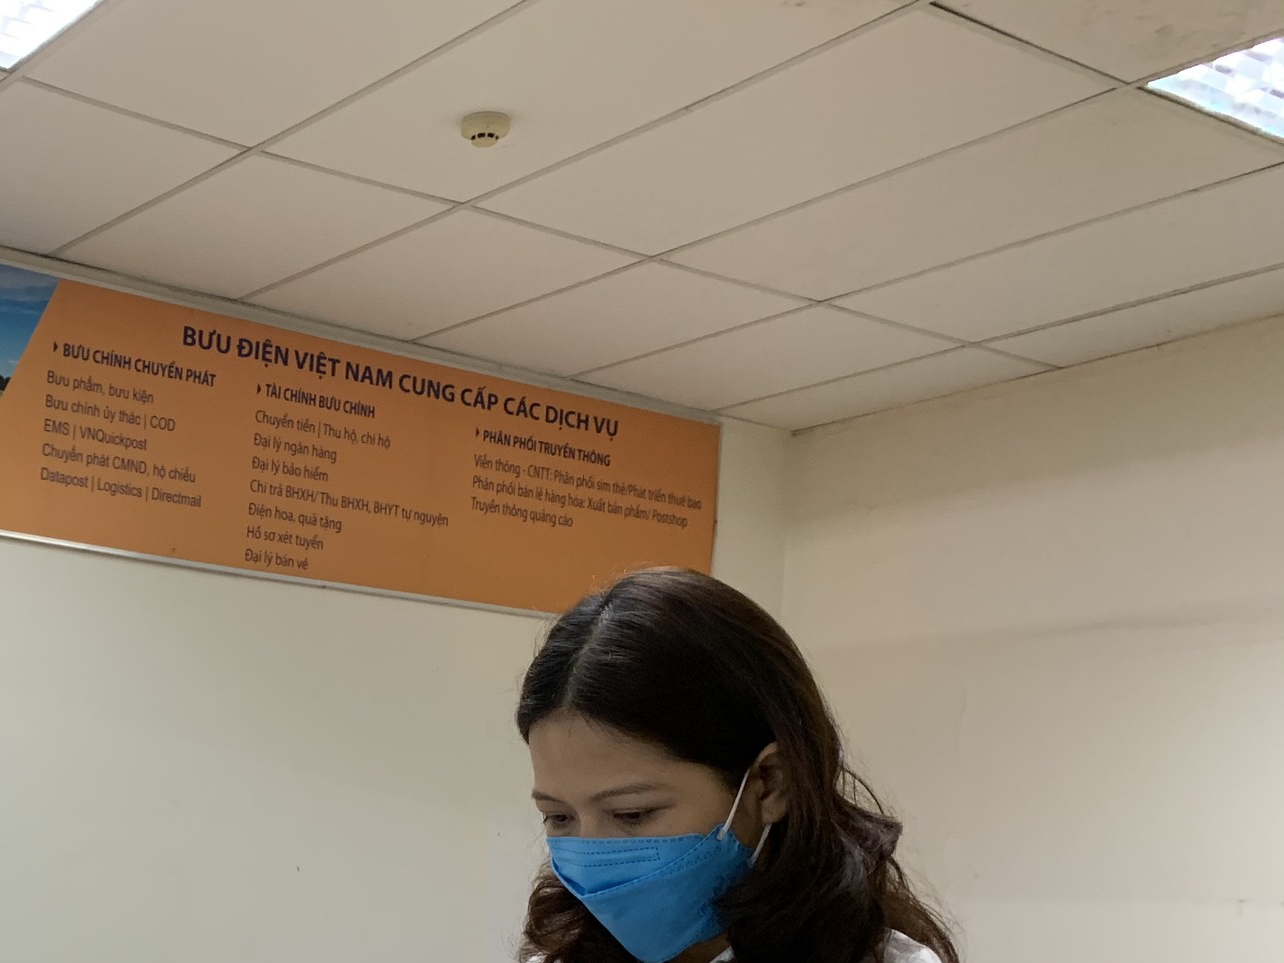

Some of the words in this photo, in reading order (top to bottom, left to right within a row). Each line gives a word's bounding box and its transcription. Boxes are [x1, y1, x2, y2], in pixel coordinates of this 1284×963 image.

[63, 343, 90, 361] BƯU
[93, 349, 132, 370] CHÍNH
[134, 358, 183, 381] CHUYỂN
[186, 369, 216, 387] PHÁT
[47, 370, 69, 387] Bưu
[73, 376, 105, 396] phẩm,
[109, 384, 130, 399] bưu
[133, 388, 154, 405] kiện
[183, 326, 231, 354] BƯU
[237, 338, 289, 368] ĐIỆN
[294, 350, 340, 380] VIỆT
[345, 361, 393, 389] NAM
[398, 374, 455, 403] CUNG
[461, 386, 499, 411] CẤP
[503, 396, 541, 421] CÁC
[545, 405, 590, 431] DỊCH
[593, 416, 619, 441] VỤ
[265, 382, 281, 399] TÀI
[283, 388, 316, 407] CHÍNH
[318, 395, 341, 412] BƯU
[343, 400, 375, 418] CHÍNH
[45, 394, 67, 411] Bưu
[71, 400, 100, 418] chính
[103, 405, 115, 423] ủy
[119, 410, 141, 426] thác
[149, 415, 176, 432] COD
[255, 409, 294, 430] Chuyển
[323, 423, 342, 439] Thu
[361, 432, 376, 446] chi
[378, 435, 391, 451] hộ
[44, 418, 70, 436] EMS
[80, 426, 147, 451] VNQuickpost
[253, 433, 271, 451] Đại
[273, 436, 282, 453] lý
[284, 441, 309, 457] ngân
[312, 444, 337, 464] hàng
[483, 430, 511, 447] PHÂN
[513, 435, 537, 452] PHỐI
[538, 441, 576, 460] TRUYỀN
[577, 449, 611, 467] THÔNG
[42, 443, 83, 464] Chuyển
[86, 450, 109, 467] phát
[112, 456, 150, 477] CMND,
[153, 464, 166, 479] hộ
[168, 466, 196, 484] chiếu
[252, 456, 269, 474] Đại
[271, 459, 280, 476] lý
[282, 461, 302, 478] bảo
[304, 466, 329, 482] hiểm
[495, 458, 521, 479] thông
[596, 480, 611, 493] sim
[40, 467, 88, 489] Datapost
[97, 478, 142, 498] Logistics
[152, 487, 202, 508] Directmail
[250, 479, 267, 494] Chi
[269, 483, 283, 497] trả
[320, 492, 339, 507] Thu
[341, 496, 371, 514] BHXH,
[373, 501, 400, 517] BHYT
[413, 511, 449, 527] nguyện
[545, 488, 566, 508] hàng
[248, 502, 273, 521] Điện
[274, 507, 295, 523] hoa,
[319, 516, 342, 534] tặng
[502, 502, 528, 522] thông
[529, 508, 557, 528] quảng
[558, 513, 574, 528] cáo
[244, 548, 262, 564] Đại
[263, 550, 274, 567] lý
[275, 553, 294, 568] bán
[264, 530, 277, 542] sơ
[278, 531, 293, 544] xét
[295, 534, 324, 551] tuyển
